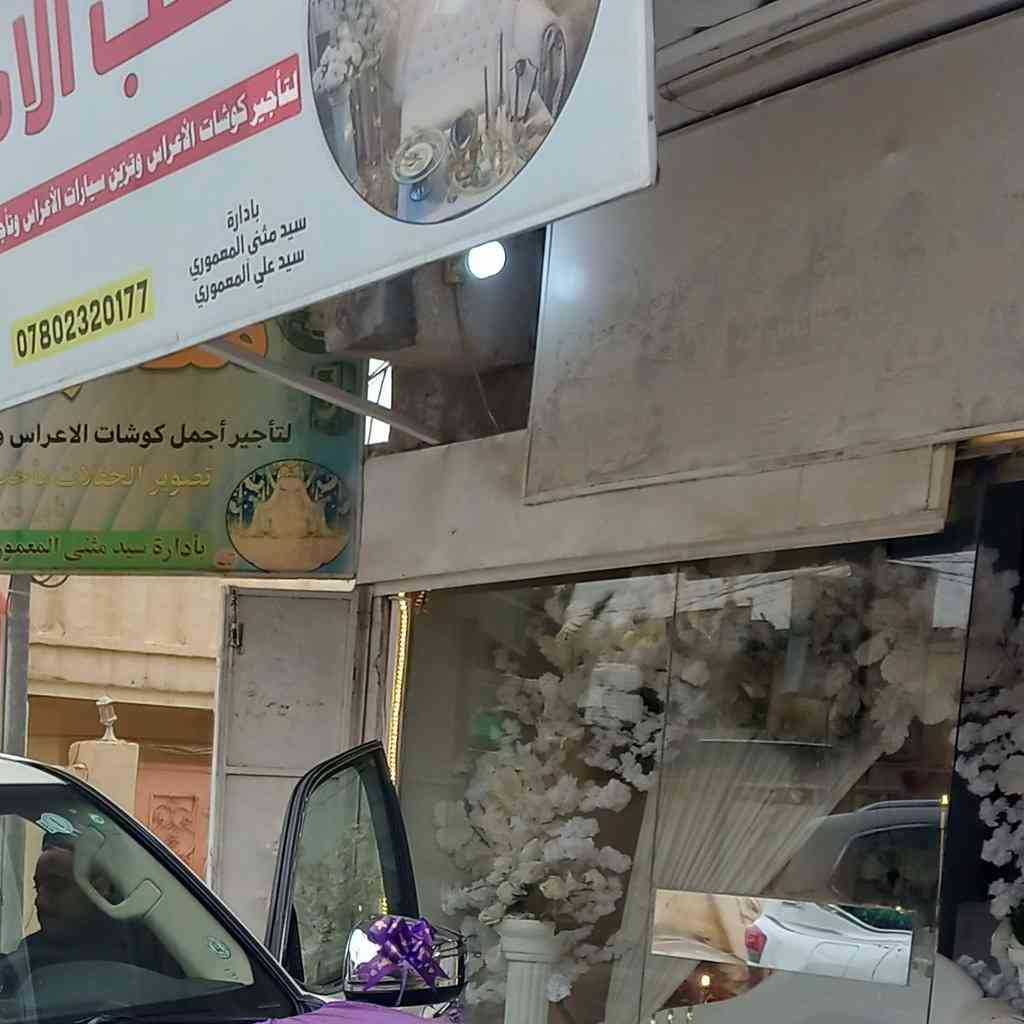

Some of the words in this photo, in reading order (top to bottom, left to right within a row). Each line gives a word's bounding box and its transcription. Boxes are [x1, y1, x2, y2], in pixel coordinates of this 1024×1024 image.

[249, 68, 299, 126] لتأجير
[199, 92, 249, 142] كوشات
[146, 117, 196, 172] الأعراس
[63, 173, 106, 207] سيارات
[247, 224, 277, 256] مثنى
[280, 217, 307, 240] سيد
[189, 234, 245, 281] المعموري
[254, 256, 275, 289] علي
[278, 249, 305, 272] سيد
[194, 262, 250, 308] المعموري
[16, 279, 148, 358] 07802320177
[9, 423, 88, 449] الاعراس
[94, 423, 166, 449] كوشات
[170, 419, 226, 449] أجمل
[228, 419, 292, 449] لتأجير
[64, 538, 106, 561] مثنى
[113, 540, 145, 557] سيد
